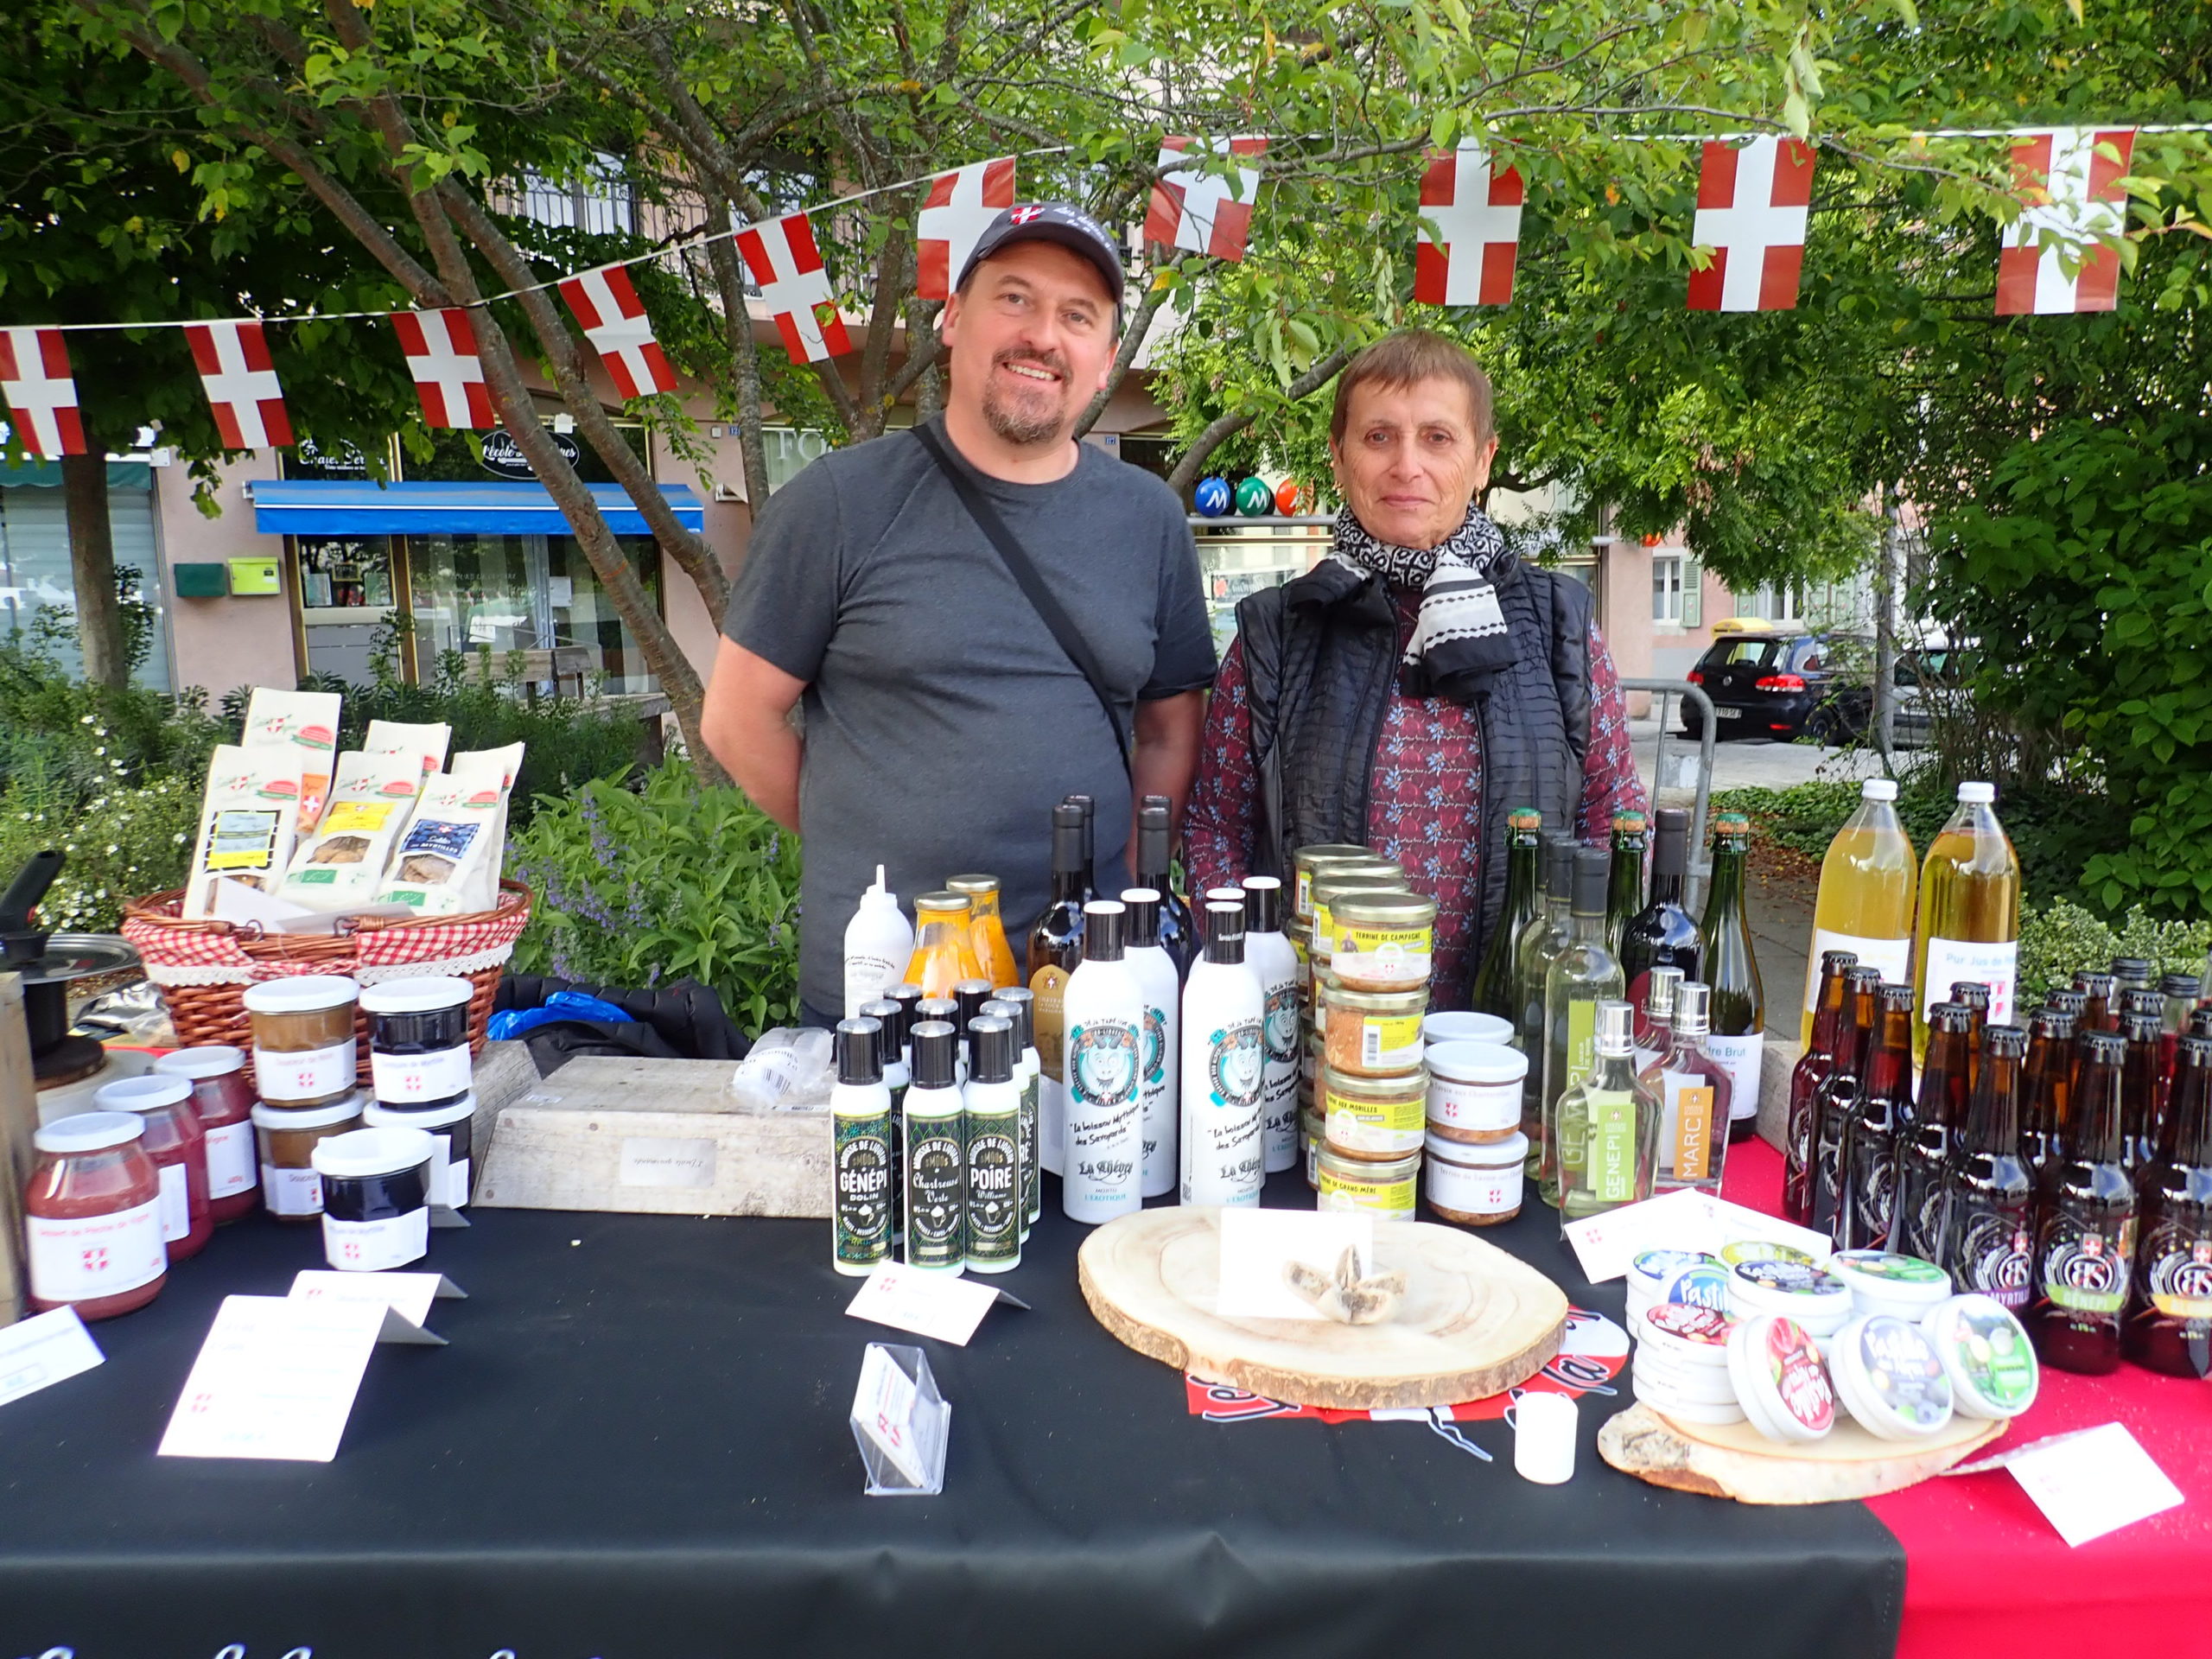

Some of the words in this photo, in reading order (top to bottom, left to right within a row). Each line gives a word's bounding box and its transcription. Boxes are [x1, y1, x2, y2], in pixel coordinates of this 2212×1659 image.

[1357, 931, 1378, 941] TERRINE
[1390, 932, 1421, 941] CAMPAGNE
[1725, 1046, 1746, 1057] Brut
[1349, 1103, 1377, 1114] MORILLES
[932, 1141, 943, 1151] DE
[987, 1138, 997, 1147] DE
[1682, 1118, 1702, 1177] MARC
[859, 1140, 869, 1151] DE
[869, 1141, 887, 1166] LIQUEUR
[1605, 1135, 1621, 1199] GENEPI
[840, 1168, 887, 1193] GÉNÉPI
[912, 1172, 959, 1190] Chartreuse
[970, 1166, 1013, 1190] POIRE
[1339, 1183, 1358, 1192] GRAND
[849, 1192, 880, 1202] DOLIN
[925, 1189, 950, 1204] Verte
